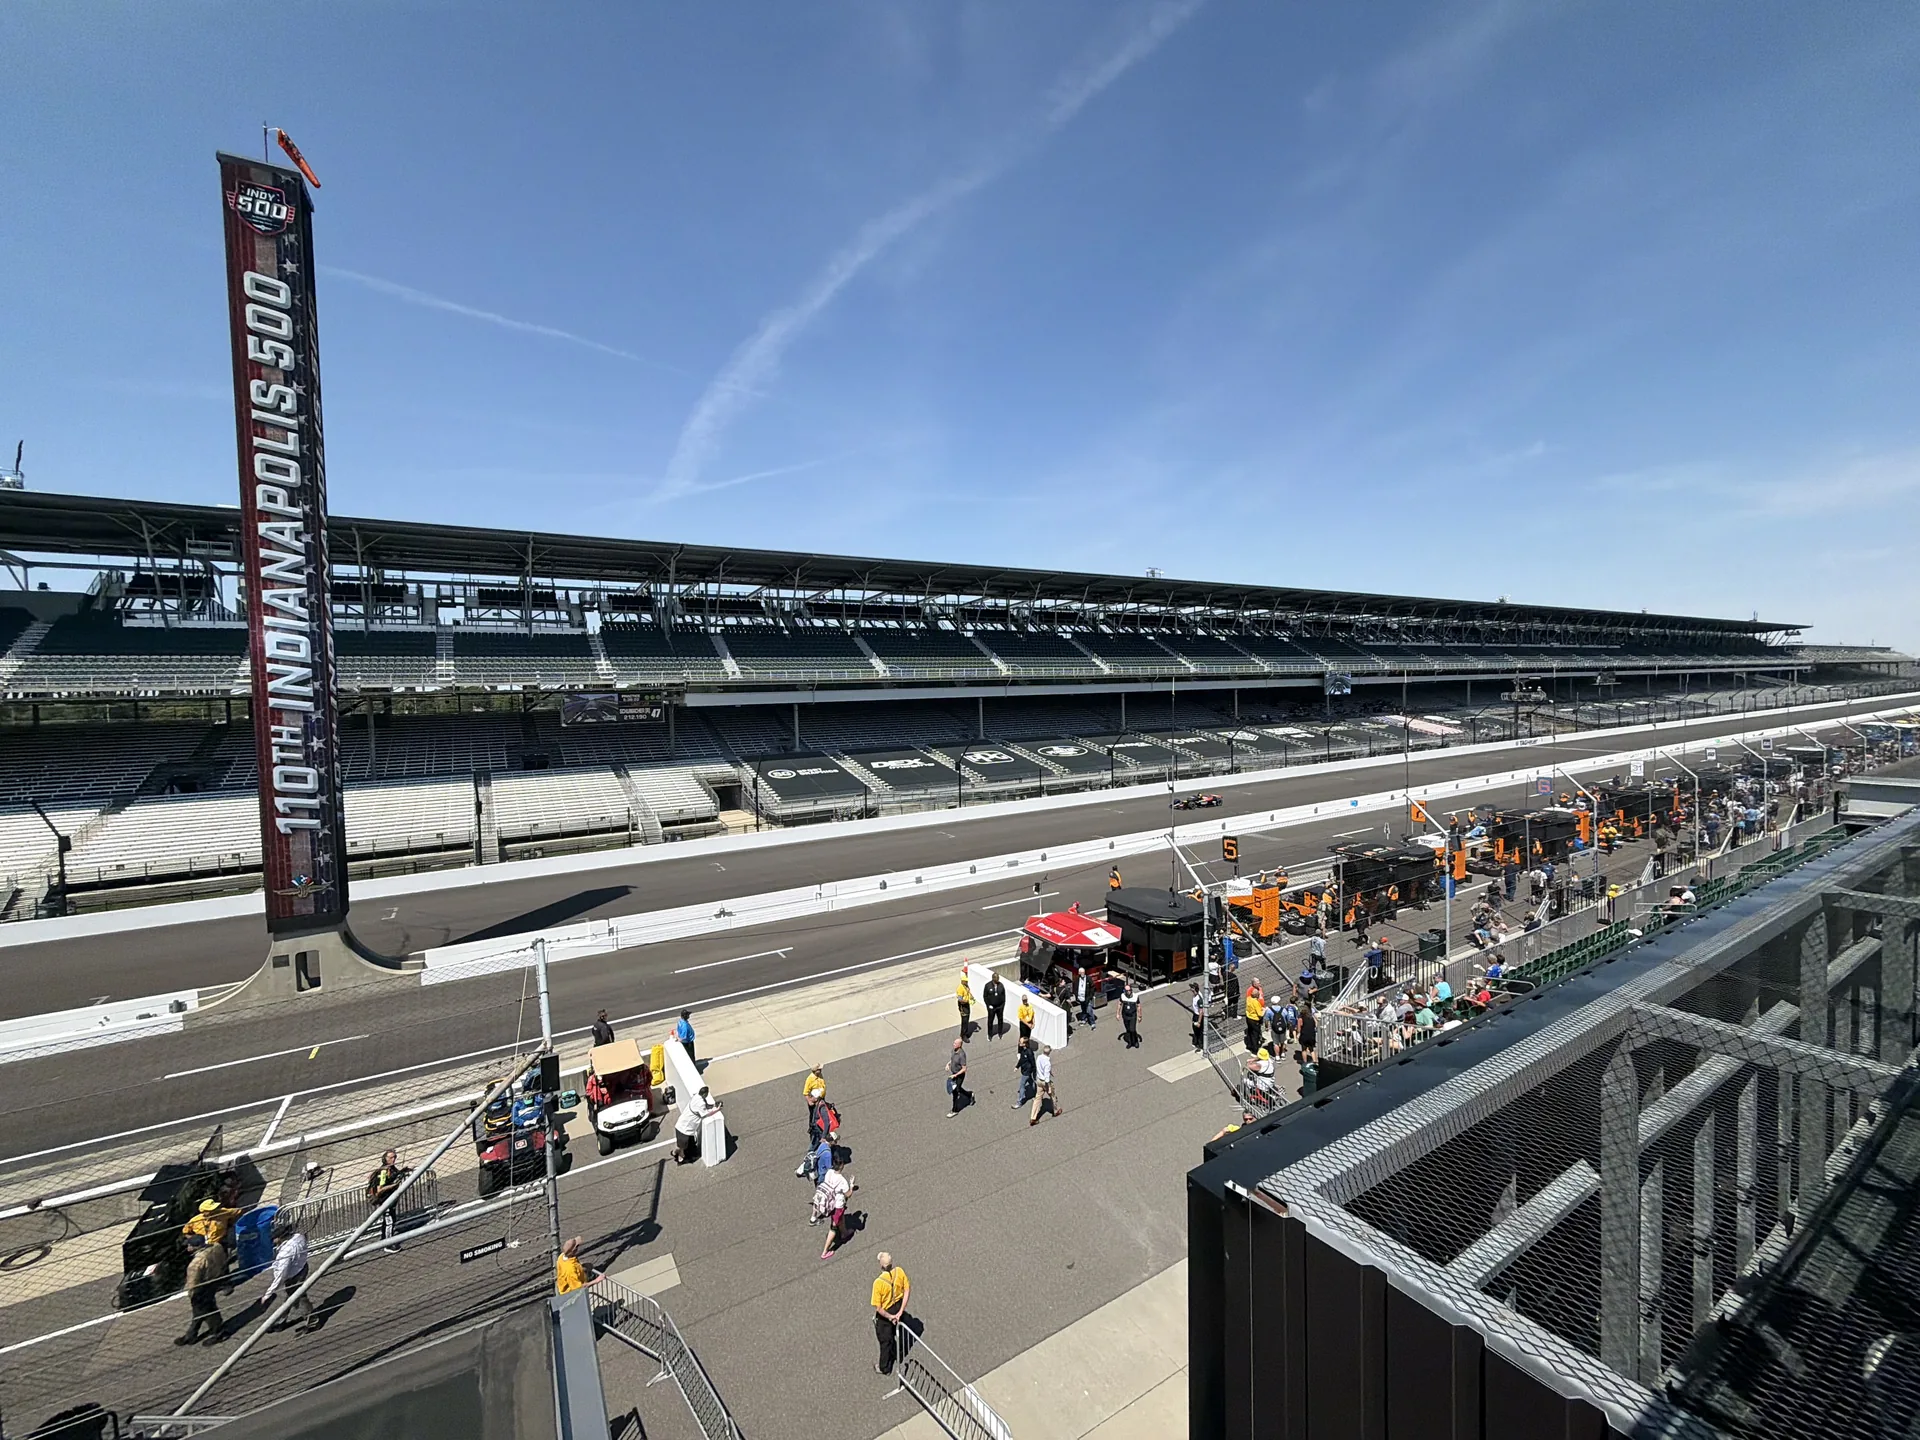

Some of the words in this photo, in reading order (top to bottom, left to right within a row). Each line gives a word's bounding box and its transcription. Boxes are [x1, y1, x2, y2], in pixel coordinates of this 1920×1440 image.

[246, 187, 276, 202] INDY
[237, 194, 288, 220] 500
[243, 270, 297, 371] 500
[250, 378, 315, 713] INDIANAPOLIS
[651, 708, 661, 718] 47
[270, 724, 321, 835] 110TH
[1223, 839, 1237, 860] 5
[1036, 922, 1067, 937] Firestone
[463, 1251, 474, 1260] NO
[474, 1242, 502, 1256] SMOKING
